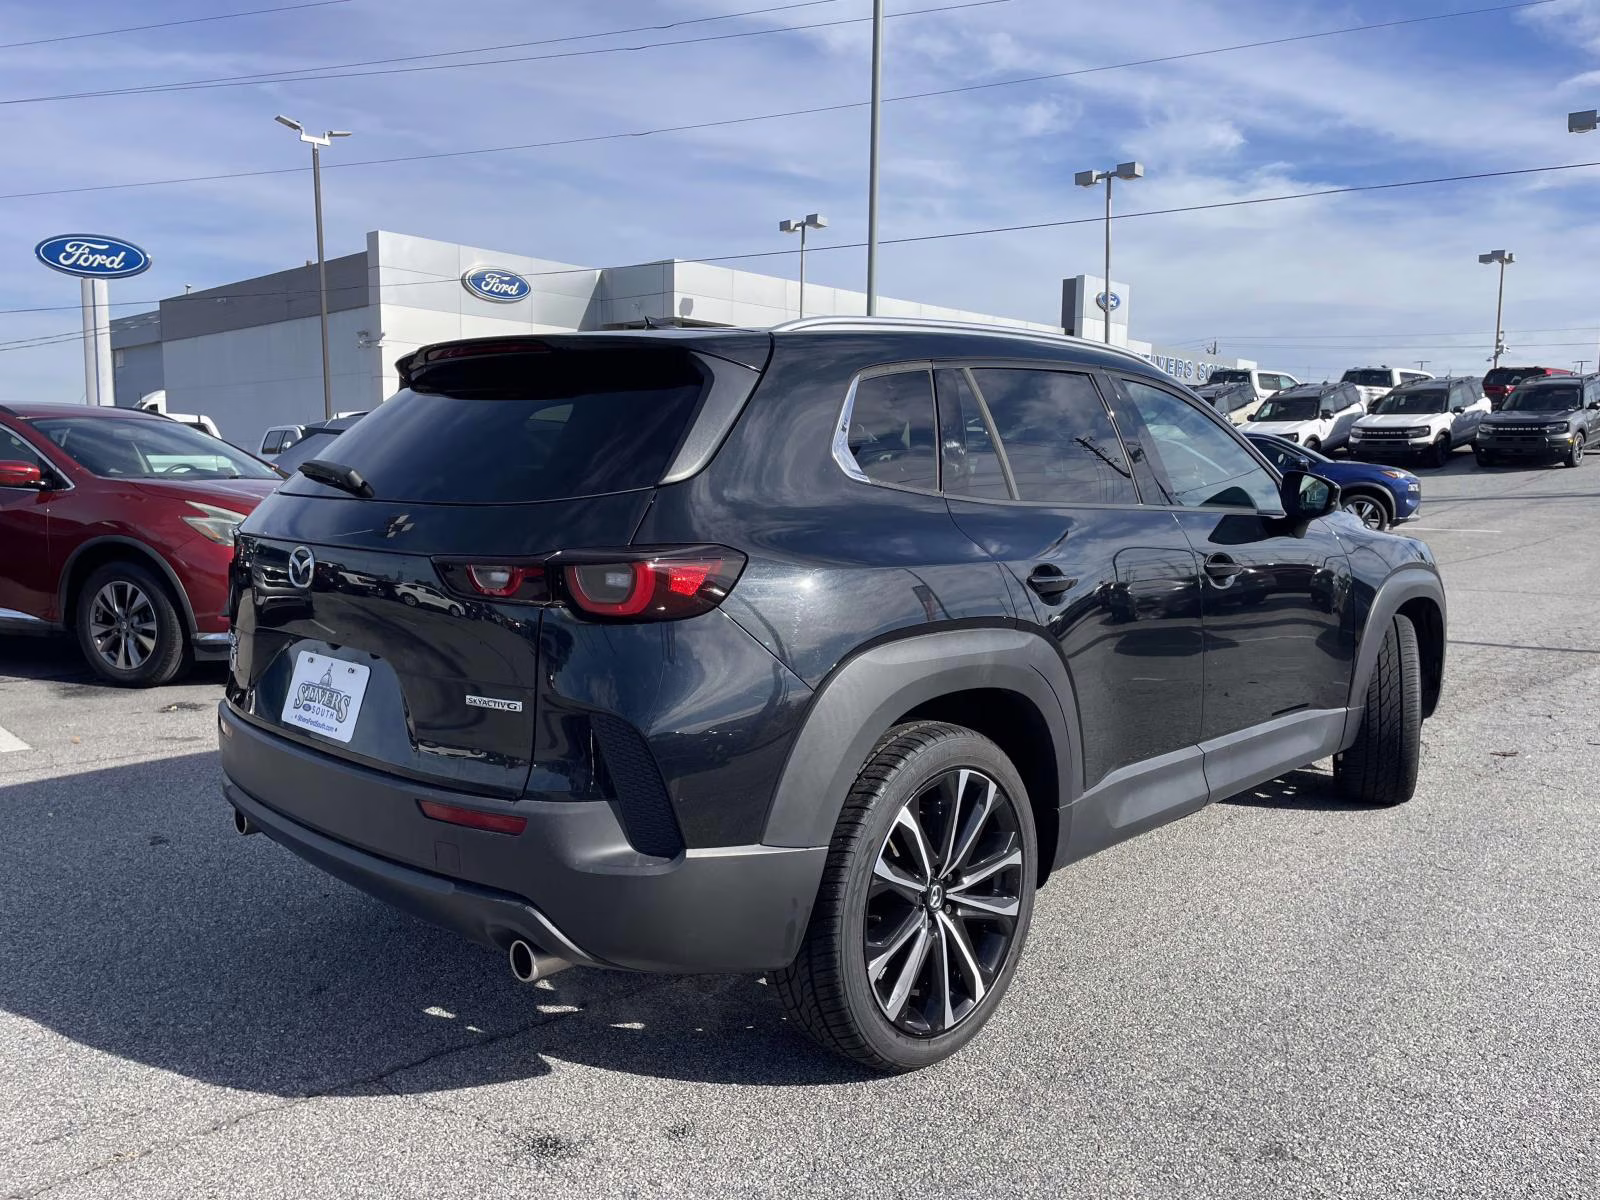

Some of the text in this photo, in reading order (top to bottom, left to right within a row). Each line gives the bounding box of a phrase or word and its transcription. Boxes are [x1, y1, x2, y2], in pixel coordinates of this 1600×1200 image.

[59, 241, 126, 269] Ford
[481, 273, 519, 295] Ford
[293, 682, 352, 724] STIVERS
[311, 705, 335, 719] SOUTH
